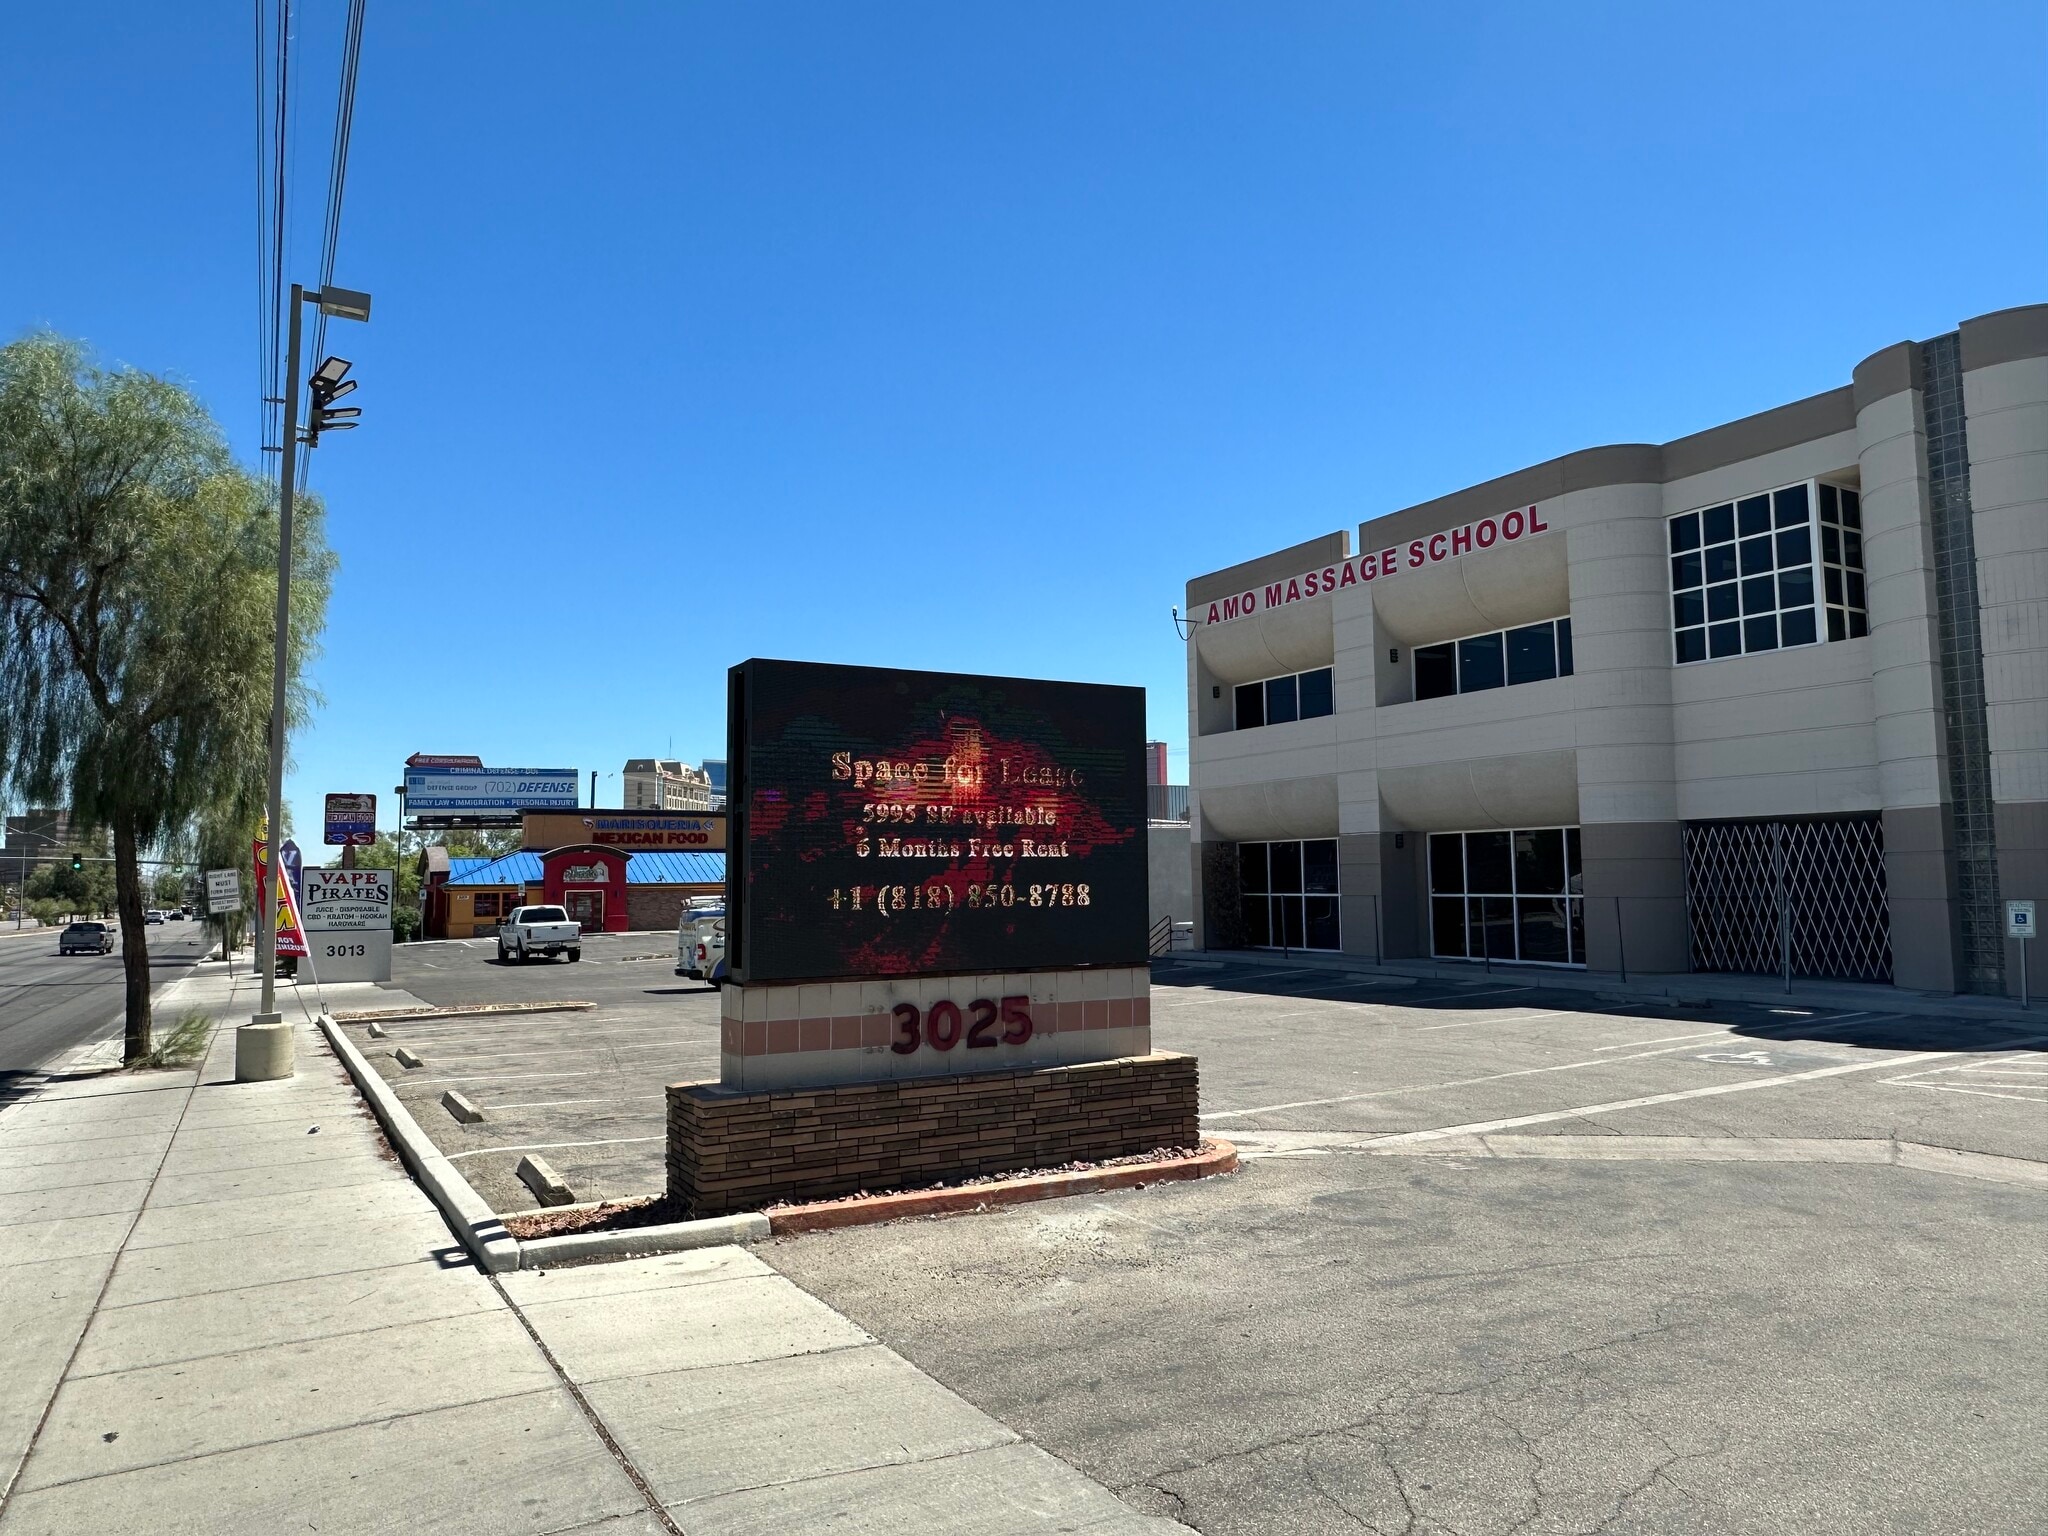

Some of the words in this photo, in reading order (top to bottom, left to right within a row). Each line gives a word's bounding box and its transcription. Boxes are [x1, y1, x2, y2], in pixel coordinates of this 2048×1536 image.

[1207, 591, 1257, 626] AMO
[1264, 547, 1398, 610] MASSAGE
[1407, 504, 1549, 569] SCHOOL
[831, 751, 929, 788] Space
[943, 754, 986, 784] for
[1000, 758, 1084, 787] Lease
[862, 803, 917, 824] 5995
[926, 804, 954, 824] SF
[596, 819, 701, 831] MARISQUERIA
[592, 832, 664, 844] MEXICAN
[667, 832, 709, 844] FOOD
[855, 837, 871, 858] 6
[878, 837, 961, 858] Months
[968, 838, 1014, 858] Free
[1020, 838, 1070, 858] Rent
[319, 872, 379, 887] VAPE
[307, 883, 389, 902] PIRATES
[828, 886, 862, 910] +1
[877, 885, 953, 918] (818)
[968, 883, 1090, 908] 850-8788
[306, 913, 322, 921] CBD
[326, 944, 365, 957] 3013
[890, 995, 1034, 1055] 3025
